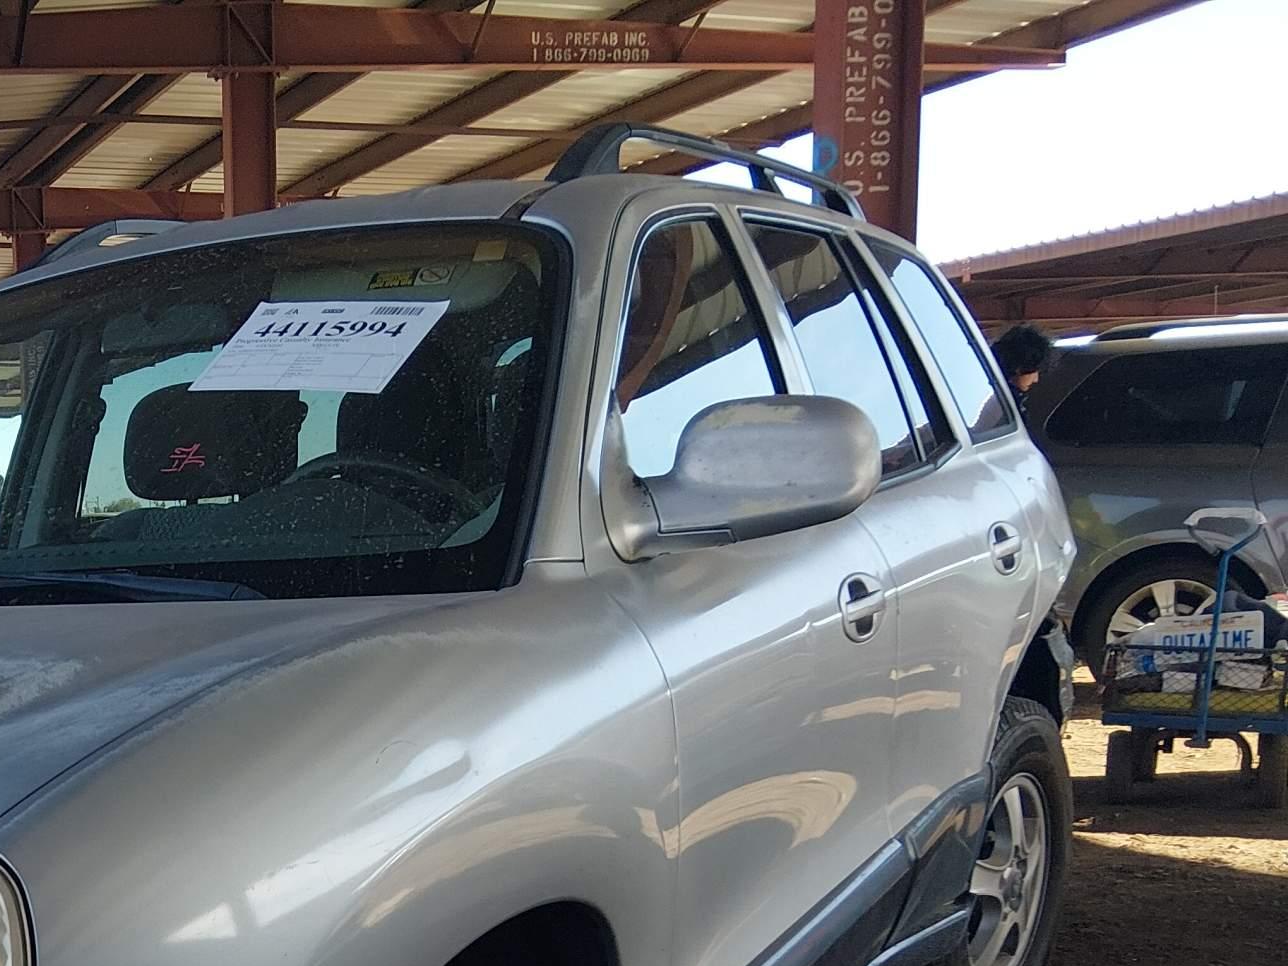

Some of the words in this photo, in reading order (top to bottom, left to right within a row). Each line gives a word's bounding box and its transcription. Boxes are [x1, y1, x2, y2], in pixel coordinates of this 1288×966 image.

[532, 31, 558, 46] U.S.
[566, 31, 619, 46] PREFAB
[845, 6, 868, 122] PREFAB
[254, 321, 408, 337] 44115994
